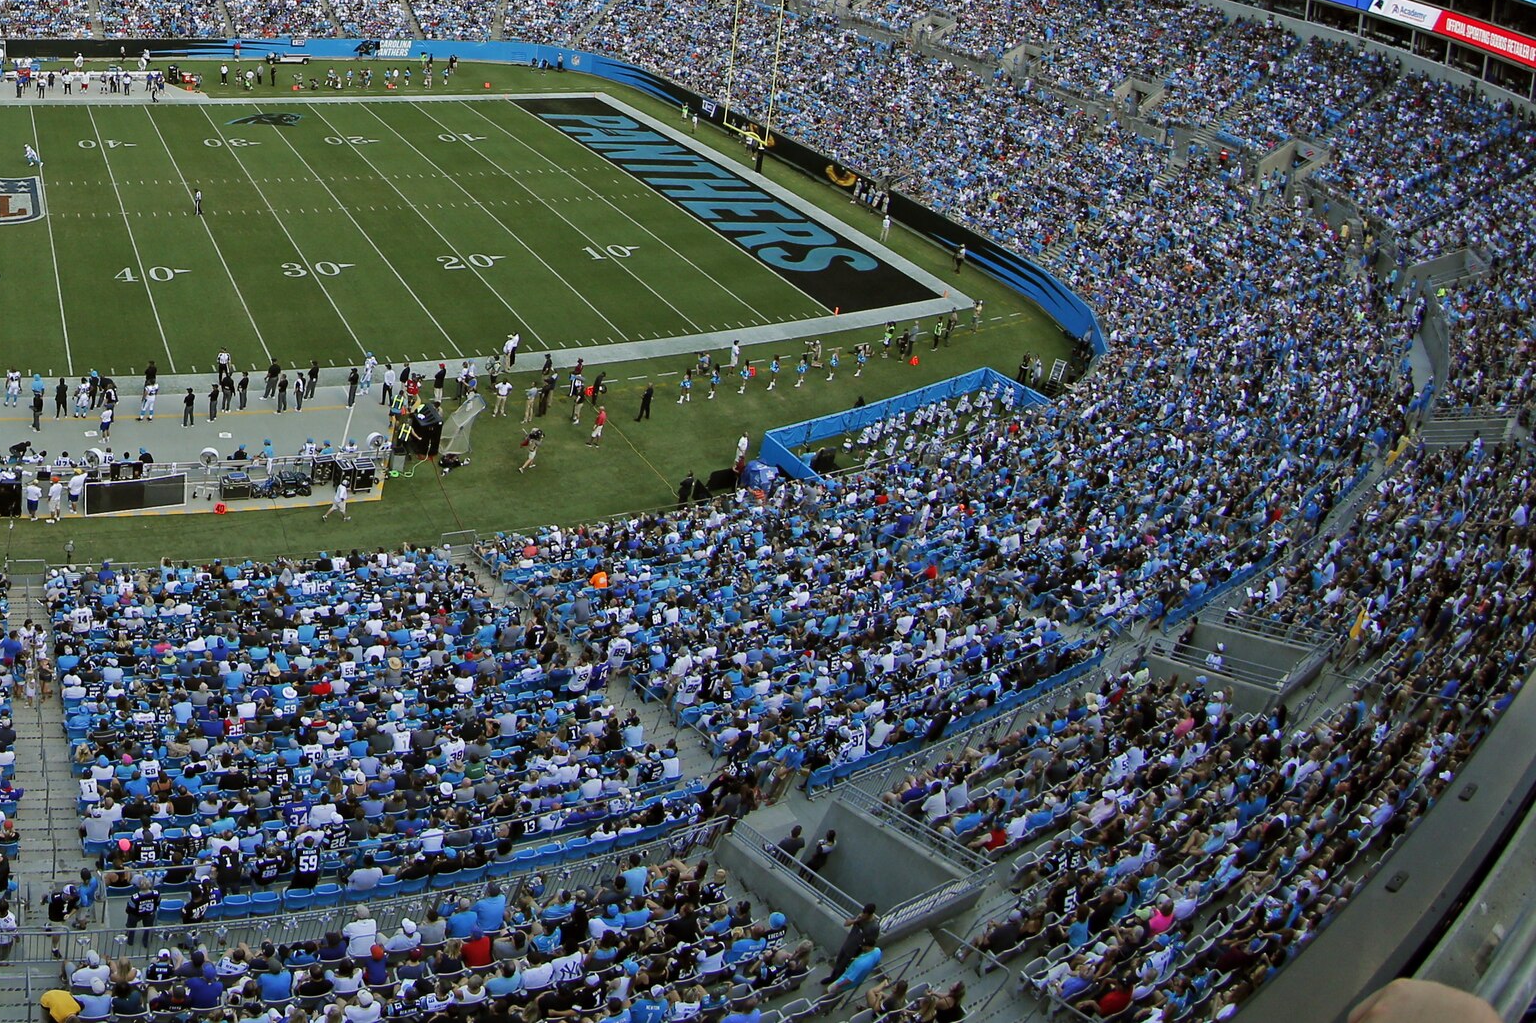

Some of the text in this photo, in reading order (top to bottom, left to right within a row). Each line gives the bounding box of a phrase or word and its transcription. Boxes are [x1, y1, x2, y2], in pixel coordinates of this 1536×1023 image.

[1400, 6, 1428, 20] Academy
[380, 40, 412, 48] CAROLINA
[1446, 18, 1466, 36] OFFICIAL
[1466, 23, 1490, 44] SPORTING
[1490, 30, 1506, 50] GOODS
[1506, 35, 1528, 57] RETAILER
[78, 139, 121, 150] 40
[203, 138, 250, 148] 30
[323, 136, 369, 146] 20
[537, 113, 879, 272] PANTHERS
[581, 244, 632, 261] 10
[436, 254, 495, 270] 20
[114, 266, 175, 283] 40
[280, 261, 342, 278] 30
[216, 504, 226, 514] 40
[290, 814, 310, 826] 34
[523, 821, 536, 832] 13
[299, 855, 318, 872] 59
